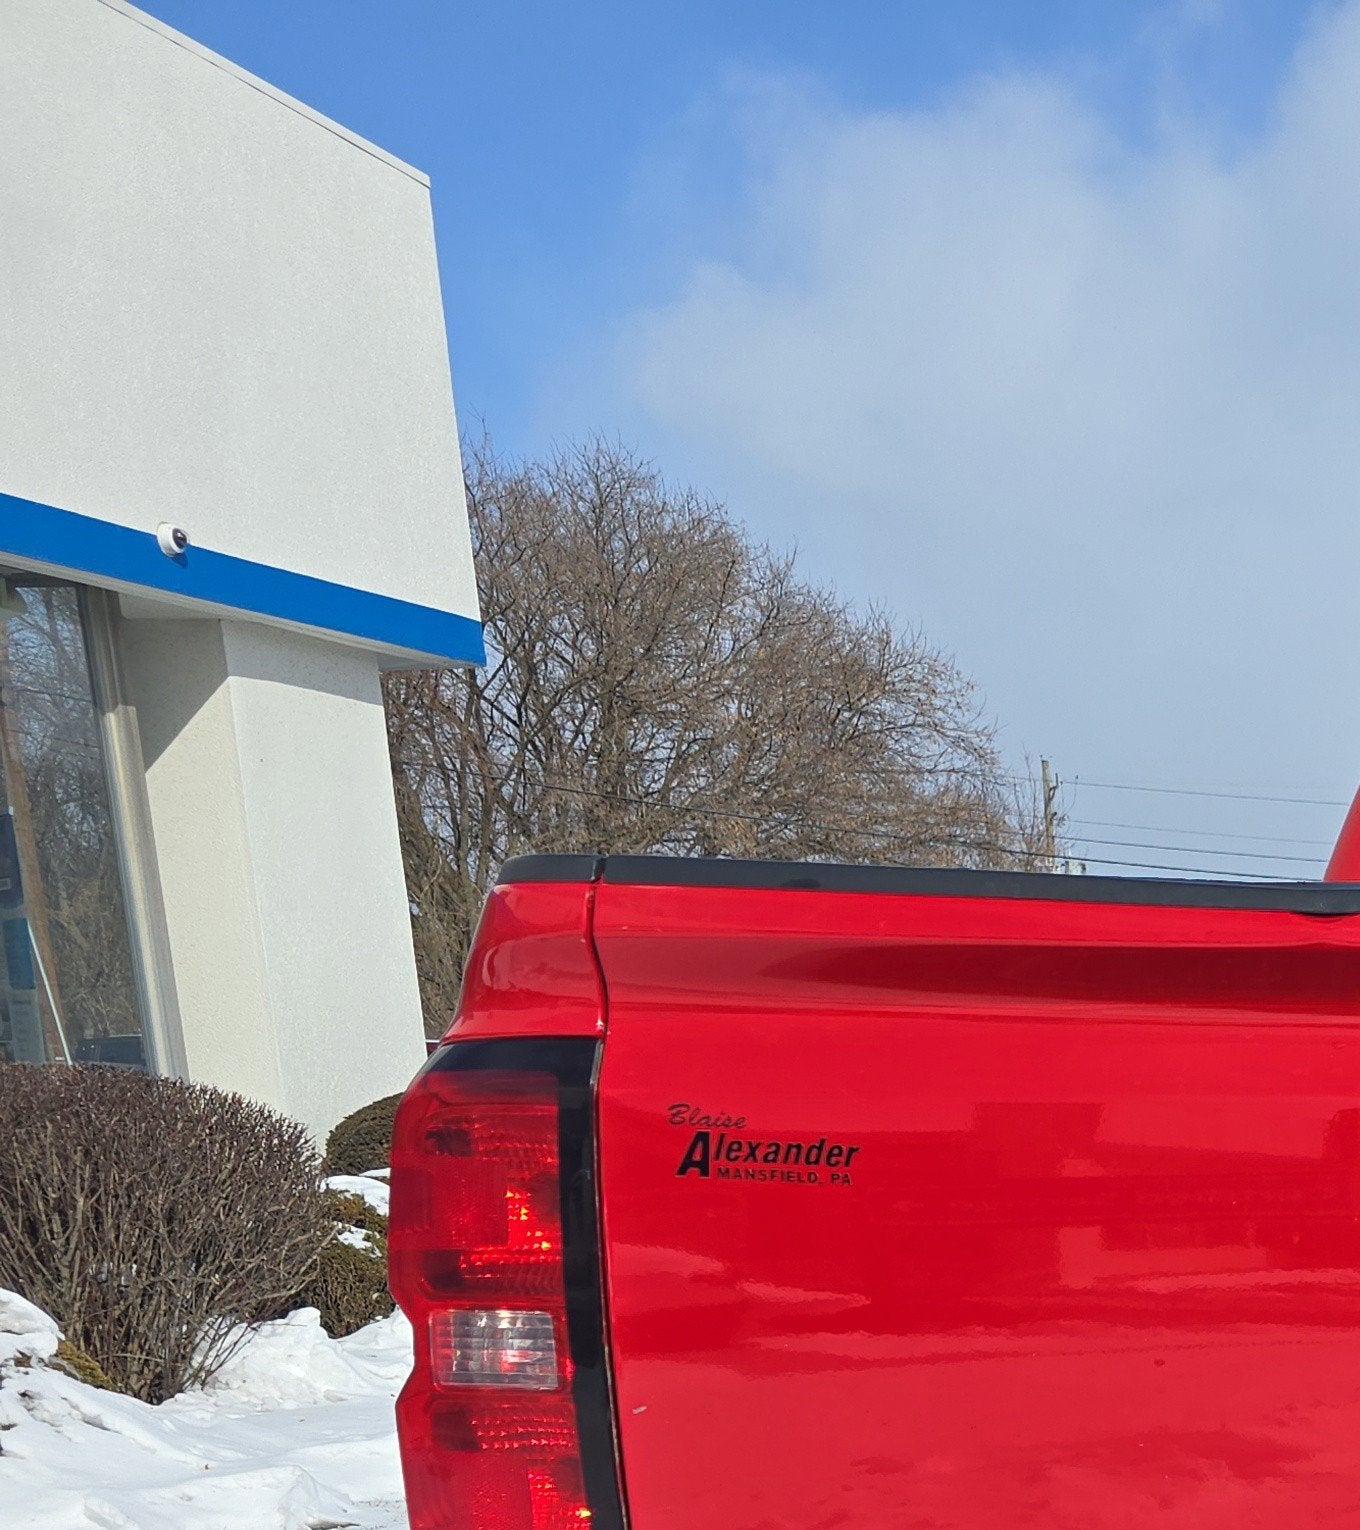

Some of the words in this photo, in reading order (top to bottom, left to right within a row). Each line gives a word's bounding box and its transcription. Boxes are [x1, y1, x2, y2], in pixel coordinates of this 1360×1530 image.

[667, 1103, 747, 1129] Blaise
[675, 1130, 861, 1177] Alexander
[829, 1173, 852, 1185] PA
